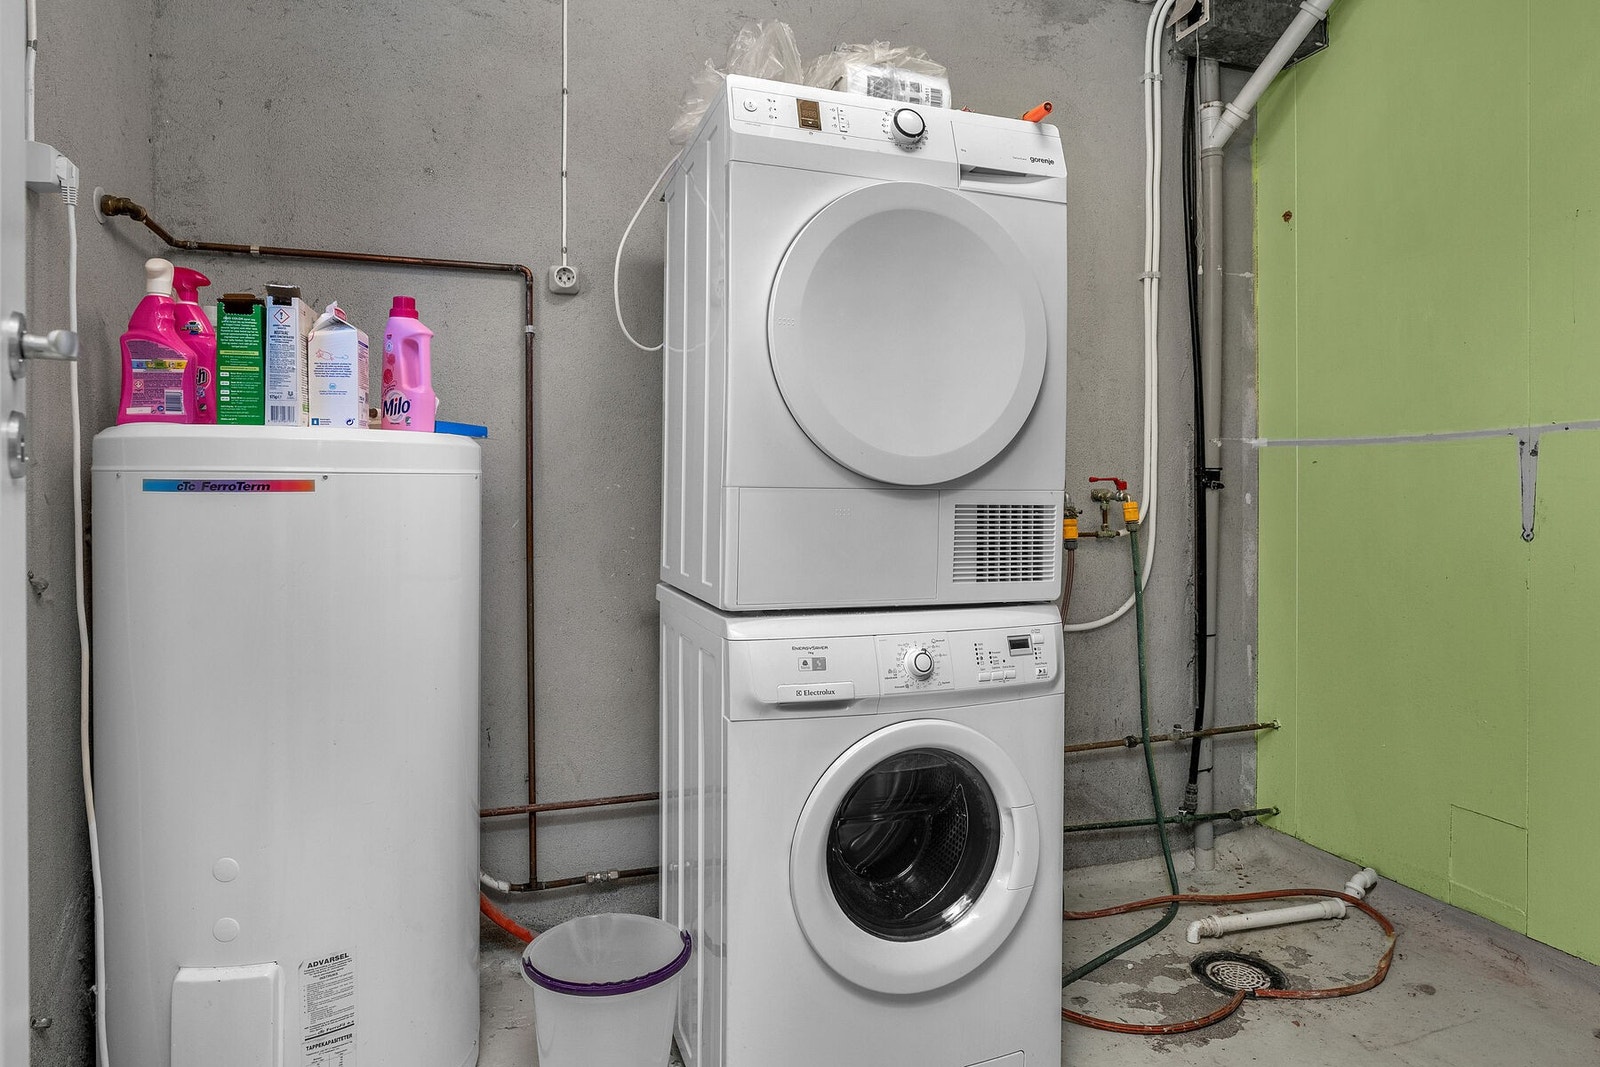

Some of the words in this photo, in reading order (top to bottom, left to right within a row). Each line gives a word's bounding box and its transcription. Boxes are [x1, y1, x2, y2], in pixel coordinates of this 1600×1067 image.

[1030, 156, 1055, 166] gorenje
[383, 396, 411, 418] Milo
[177, 481, 195, 491] cTc
[202, 482, 271, 492] FerroTerm
[307, 953, 350, 969] ADVARSEL
[306, 1033, 353, 1051] TAPPEKAPASITETER
